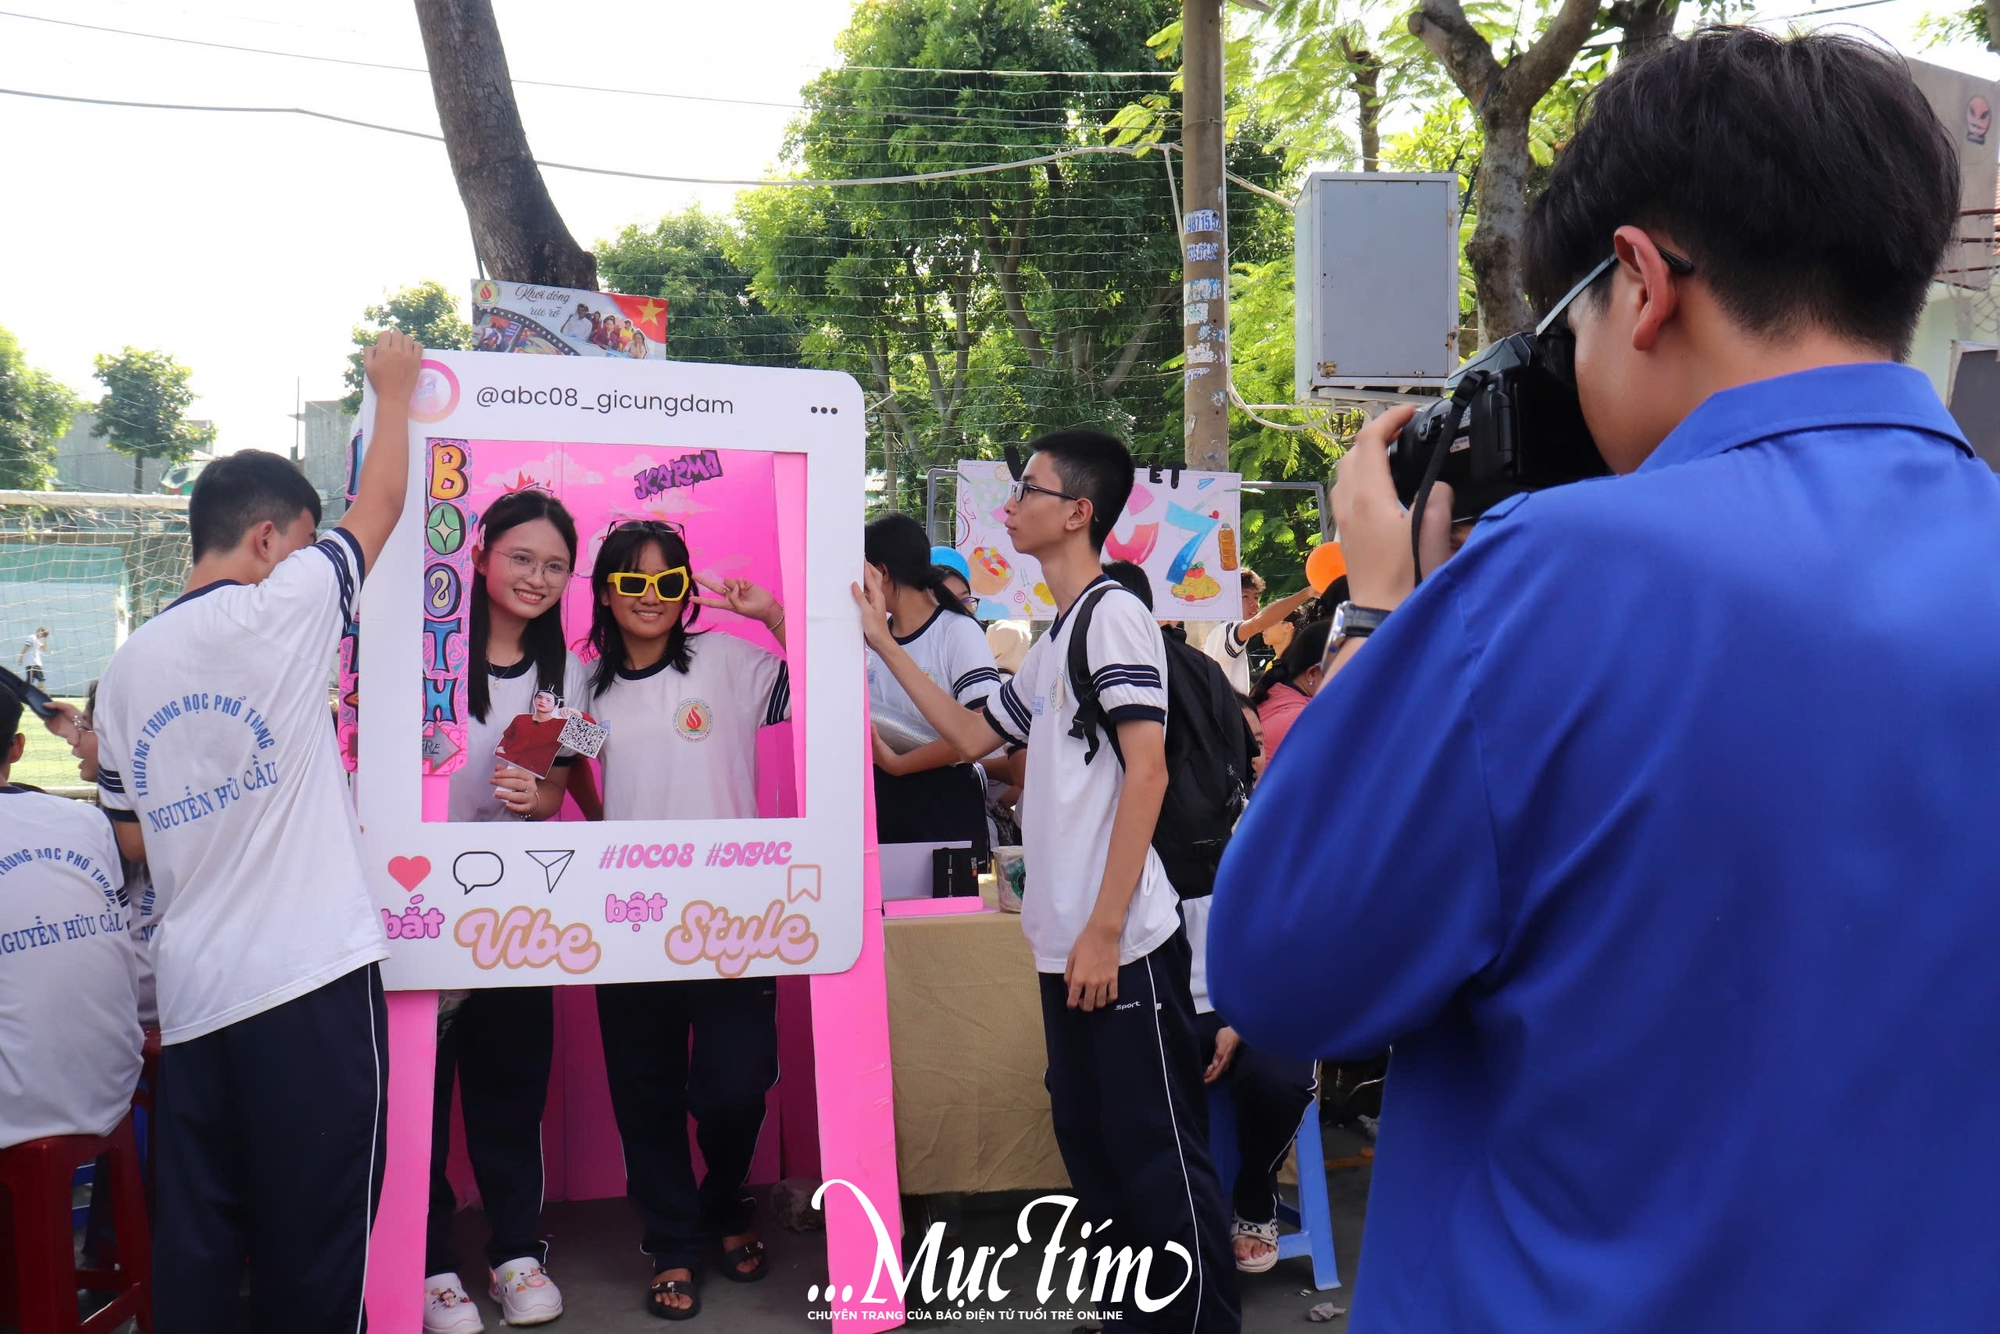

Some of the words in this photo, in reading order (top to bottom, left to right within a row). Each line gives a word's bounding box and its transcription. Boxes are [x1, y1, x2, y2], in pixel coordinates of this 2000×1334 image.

[476, 386, 733, 417] @abc08_gicungdam
[131, 739, 150, 798] TRƯỜNG
[142, 700, 181, 738] TRUNG
[182, 693, 209, 714] HỌC
[214, 695, 247, 717] PHỔ
[243, 754, 278, 791] CẦU
[599, 842, 695, 870] #10C08
[0, 916, 61, 956] GUYỄN
[381, 894, 445, 939] bắt
[454, 905, 601, 975] Vibe
[605, 891, 668, 933] bật
[664, 899, 819, 978] Style
[1115, 1000, 1141, 1011] Sport
